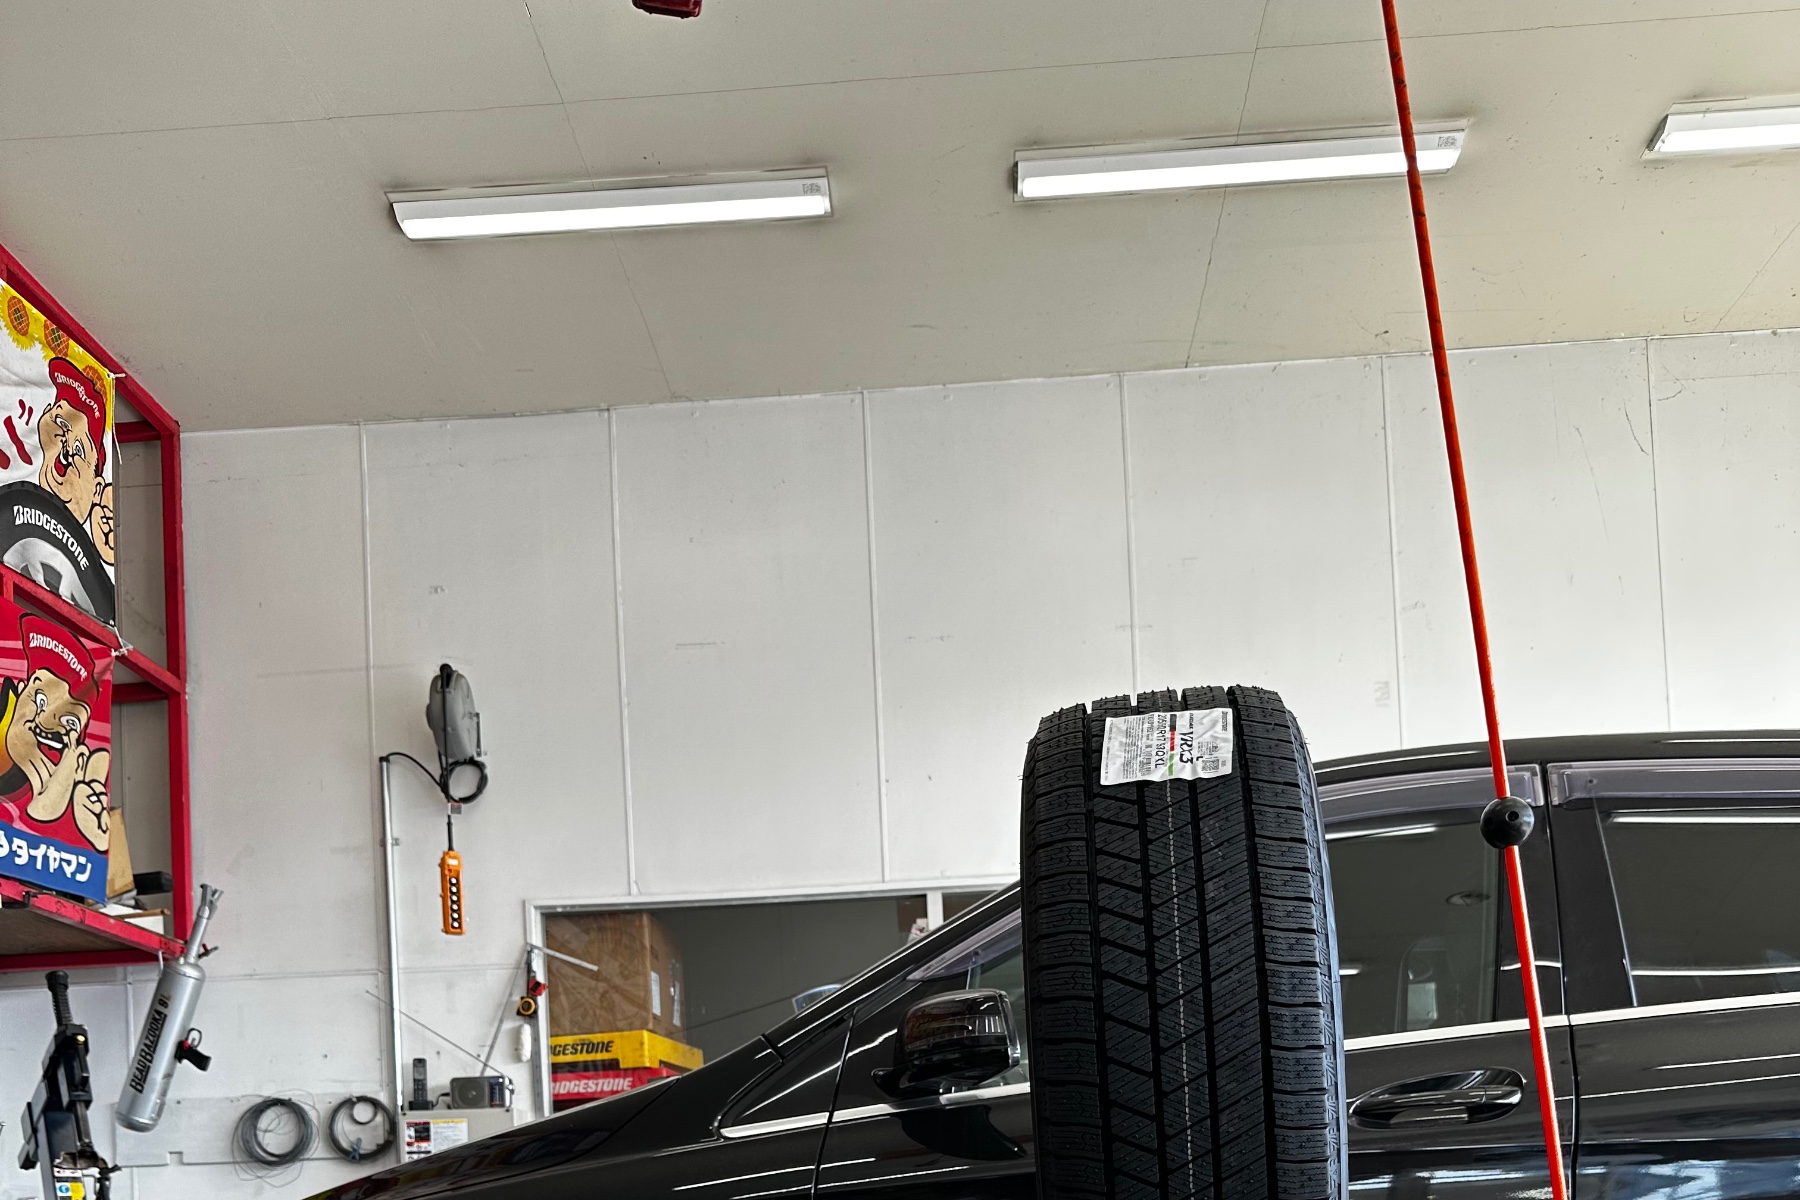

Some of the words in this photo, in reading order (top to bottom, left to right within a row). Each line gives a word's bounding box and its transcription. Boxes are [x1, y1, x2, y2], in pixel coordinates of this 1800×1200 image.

[55, 372, 100, 419] BRIDGESTONE
[13, 505, 89, 570] BRIDGESTONE
[29, 633, 88, 681] BRIDGESTONE
[1179, 731, 1194, 765] VRX3
